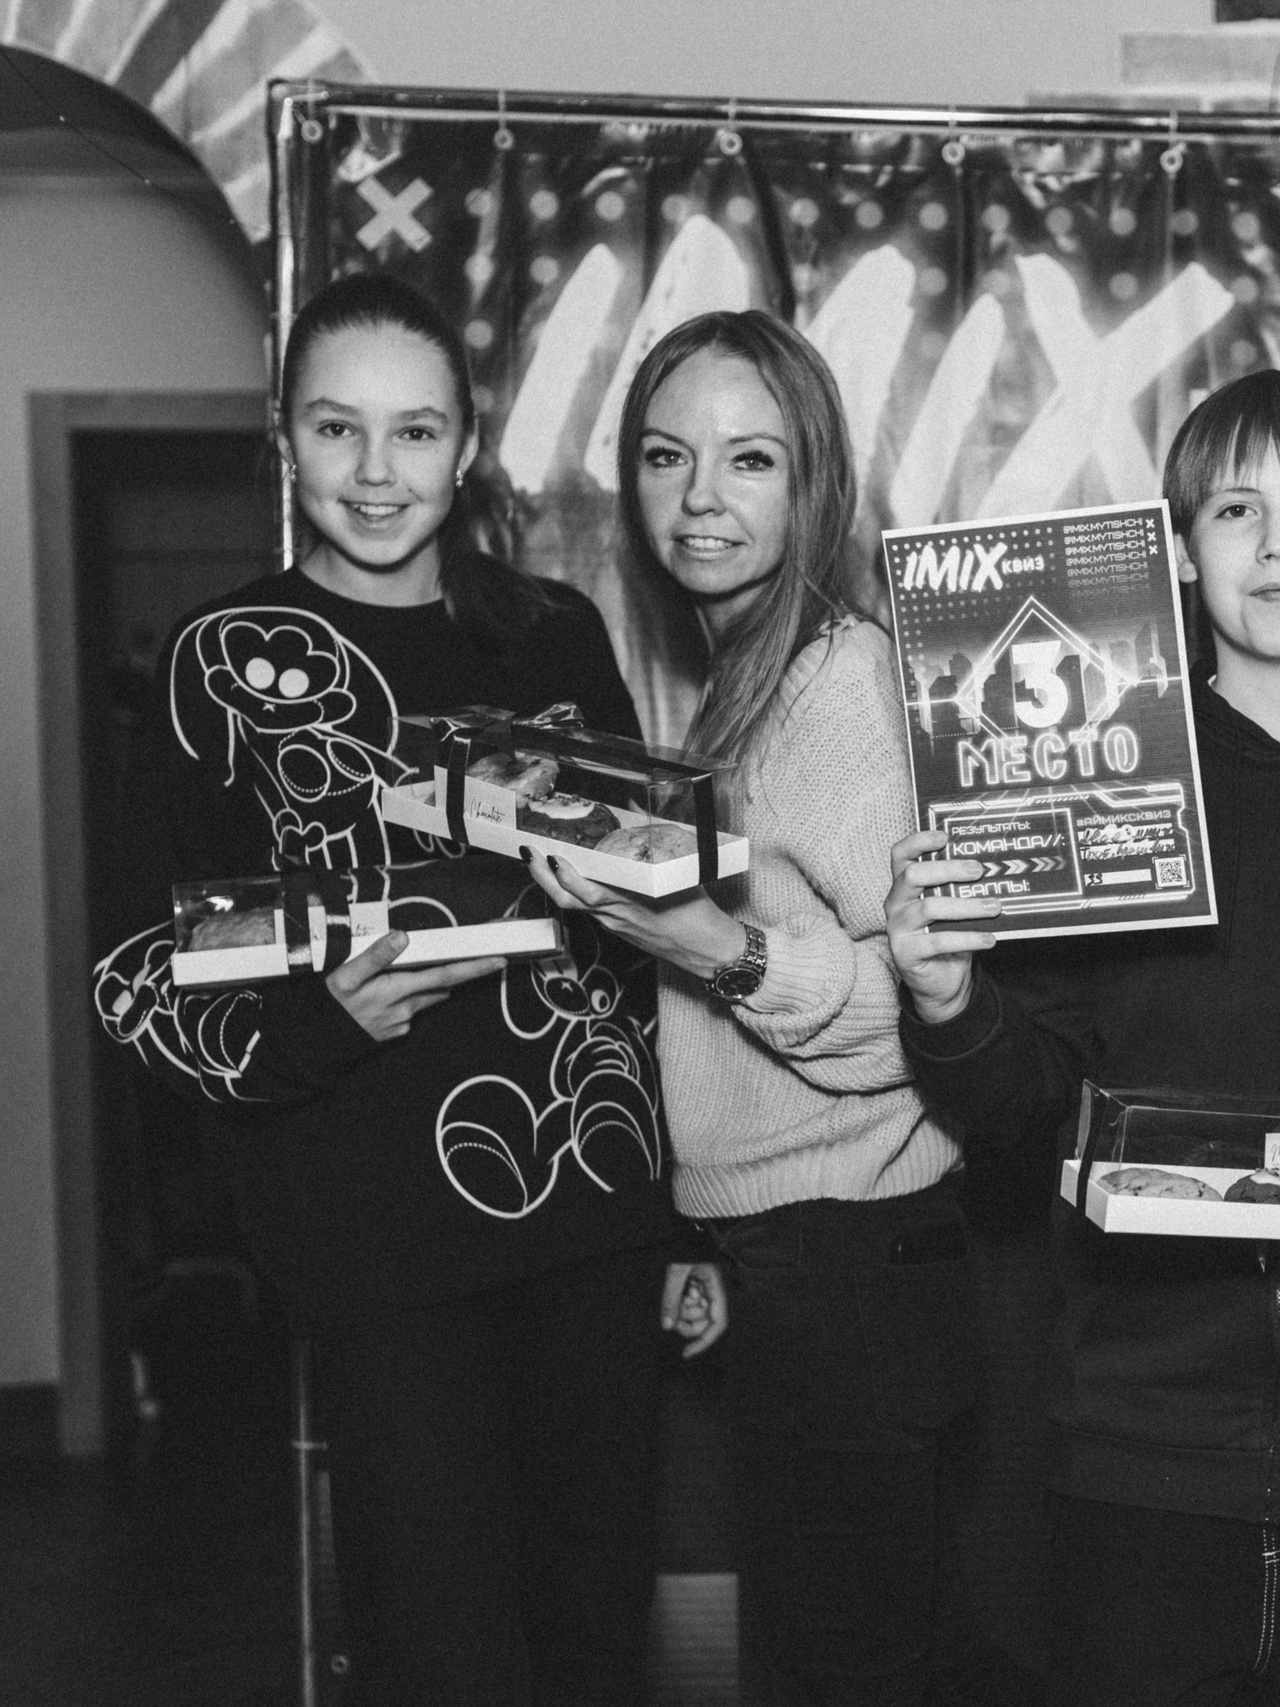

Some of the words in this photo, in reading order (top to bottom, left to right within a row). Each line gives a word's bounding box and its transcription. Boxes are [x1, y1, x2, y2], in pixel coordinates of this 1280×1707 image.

[1063, 517, 1143, 534] @IMIX.MYTISHCHI
[1064, 529, 1144, 545] @IMIX.MYTISHCHI
[1065, 540, 1145, 555] @IMIX.MYTISHCHI
[1002, 556, 1045, 574] КВИЗ
[1066, 550, 1147, 566] @IMIX.MYTISHCHI
[903, 542, 1008, 593] IMIX
[1012, 640, 1068, 728] 3
[958, 726, 1139, 787] МЕСТО
[1076, 810, 1171, 826] #АЙМИКСКВИЗ
[952, 821, 1031, 835] РЕЗУЛЬТАТЫ:
[959, 880, 1030, 898] БАЛЛЫ:
